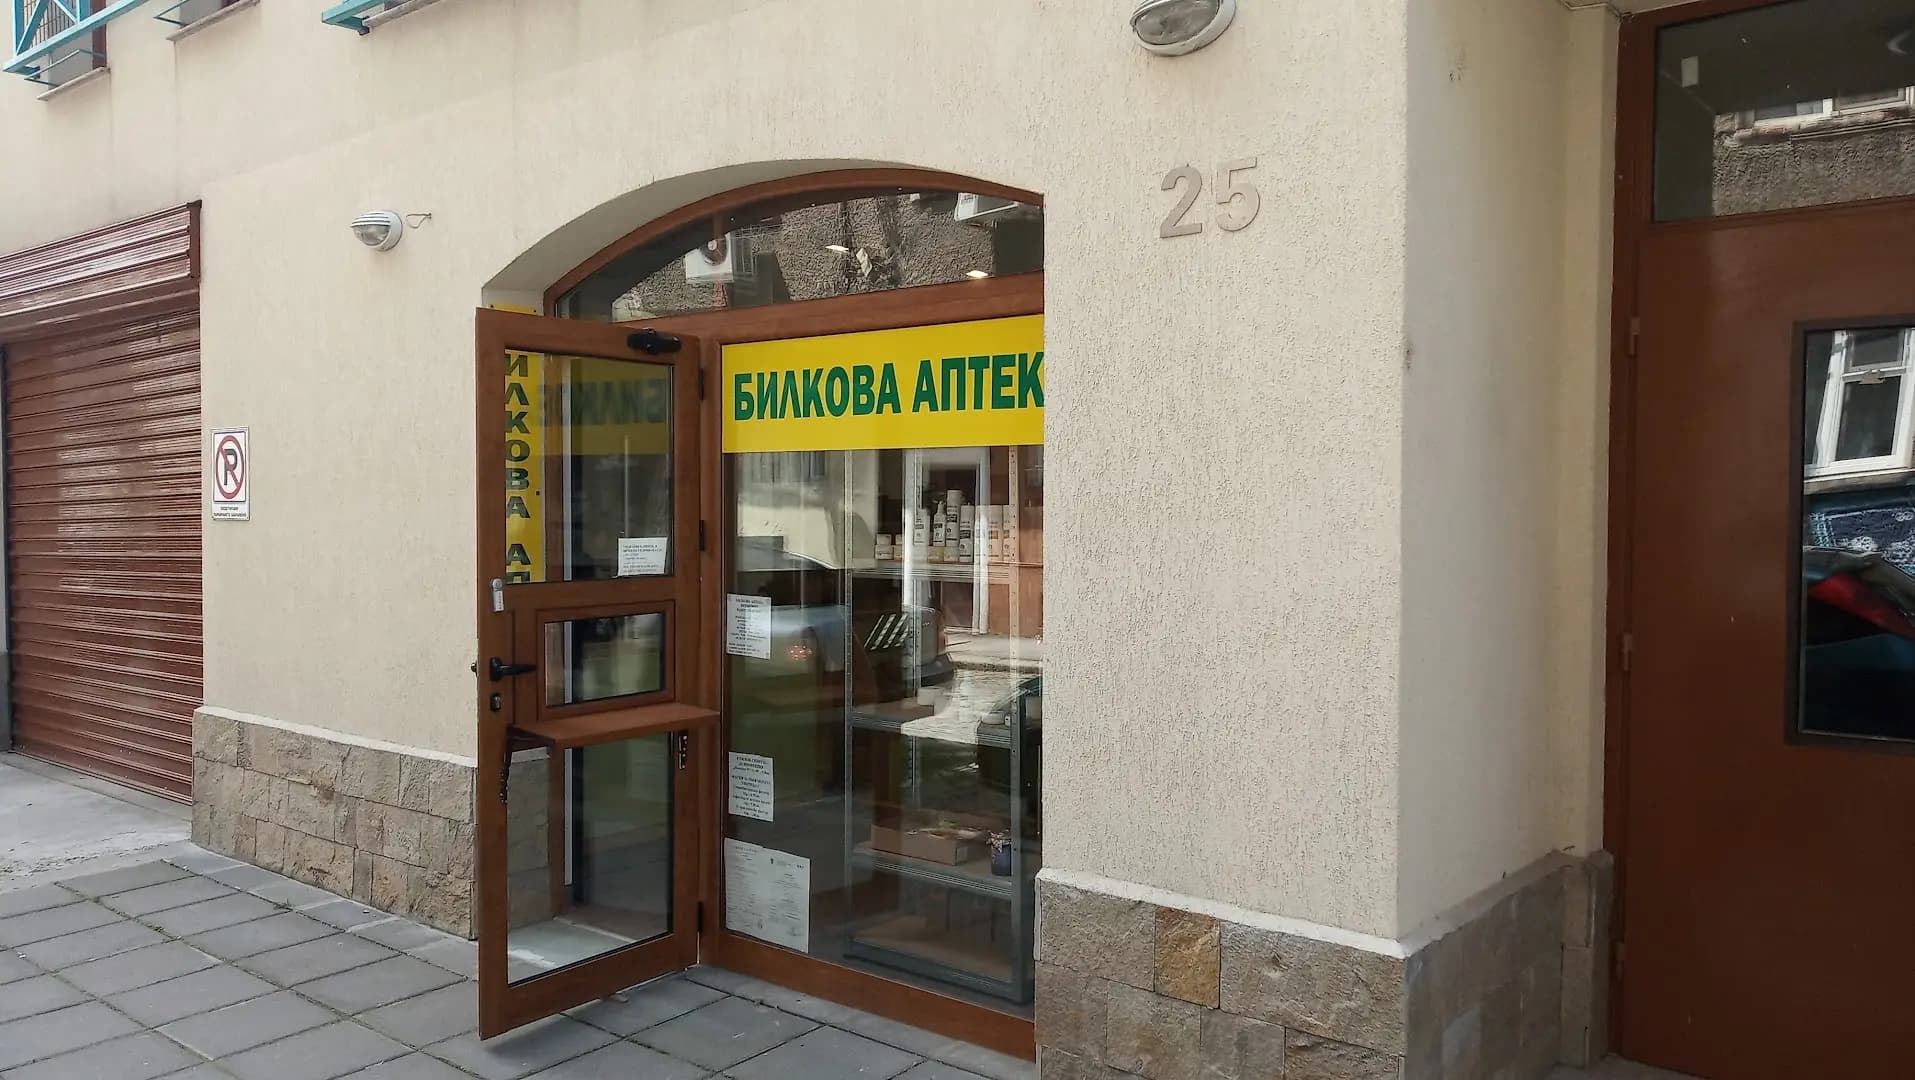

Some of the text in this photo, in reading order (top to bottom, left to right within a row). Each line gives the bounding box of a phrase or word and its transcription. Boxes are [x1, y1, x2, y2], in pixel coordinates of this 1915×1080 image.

[1159, 156, 1260, 238] 25
[735, 363, 901, 421] БИЛКОВА
[912, 352, 1044, 412] АПТЕК
